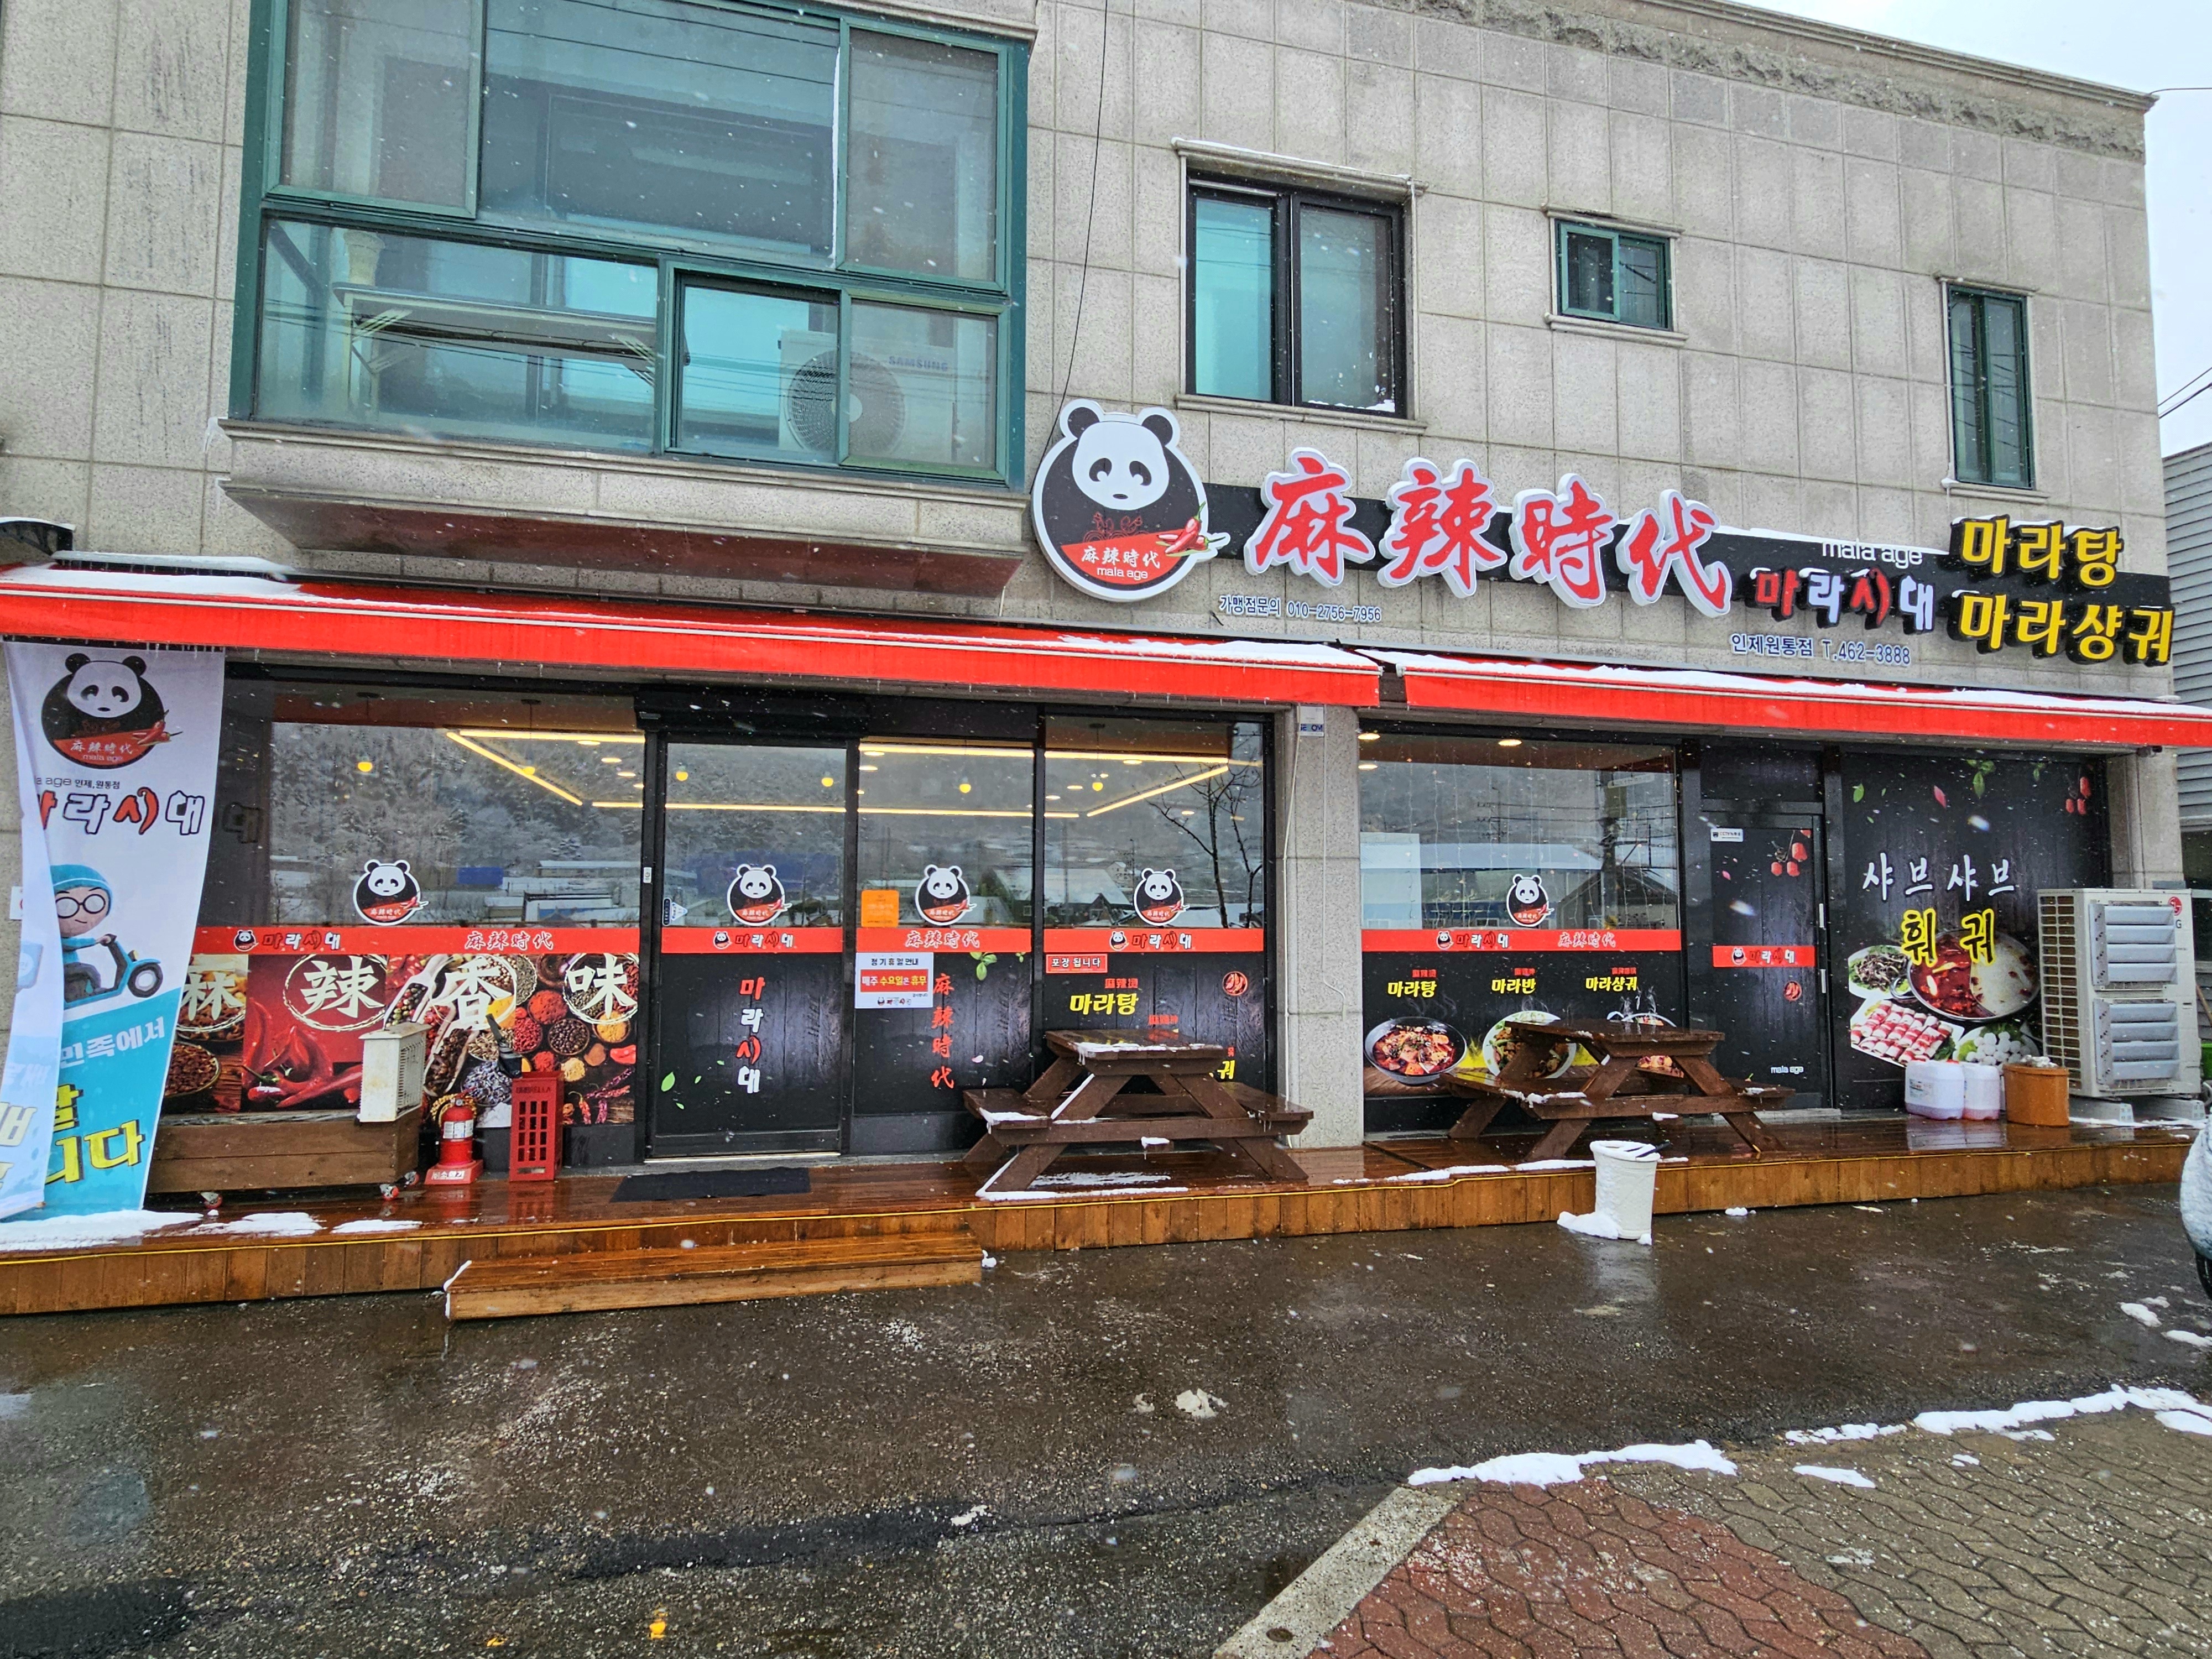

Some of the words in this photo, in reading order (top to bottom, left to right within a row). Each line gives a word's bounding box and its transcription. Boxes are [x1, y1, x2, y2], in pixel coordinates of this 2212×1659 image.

[889, 356, 948, 372] SAMSUNG
[1252, 453, 1729, 612] 麻辣時代
[1081, 545, 1160, 569] 麻辣時代
[1822, 539, 1876, 561] mala
[1881, 547, 1922, 569] age
[1961, 518, 2122, 586] 마라탕
[1097, 567, 1124, 577] mala
[1126, 571, 1148, 581] age
[1220, 596, 1281, 615] 가맹점문의
[1287, 601, 1381, 621] 010-2756-7956
[1755, 567, 1934, 631] 마라시대
[1960, 594, 2173, 662] 마라샹궈
[1731, 634, 1813, 657] 인제원통점
[45, 777, 71, 787] age
[1863, 852, 2015, 901] 샤브샤브
[464, 931, 554, 951] 麻辣時代
[905, 931, 980, 948] 麻辣時代
[1901, 907, 1995, 967] 훠궈
[1051, 958, 1070, 968] 포장
[1073, 957, 1101, 968] 됩니다
[862, 975, 878, 986] 매주
[879, 975, 910, 986] 수요일은
[911, 975, 927, 986] 휴무
[1387, 980, 1437, 998] 마라탕
[1491, 978, 1536, 994] 마라반
[1070, 993, 1139, 1015] 마라탕
[931, 973, 955, 1089] 麻辣時代
[1771, 1065, 1789, 1073] mala
[1790, 1066, 1804, 1074] age
